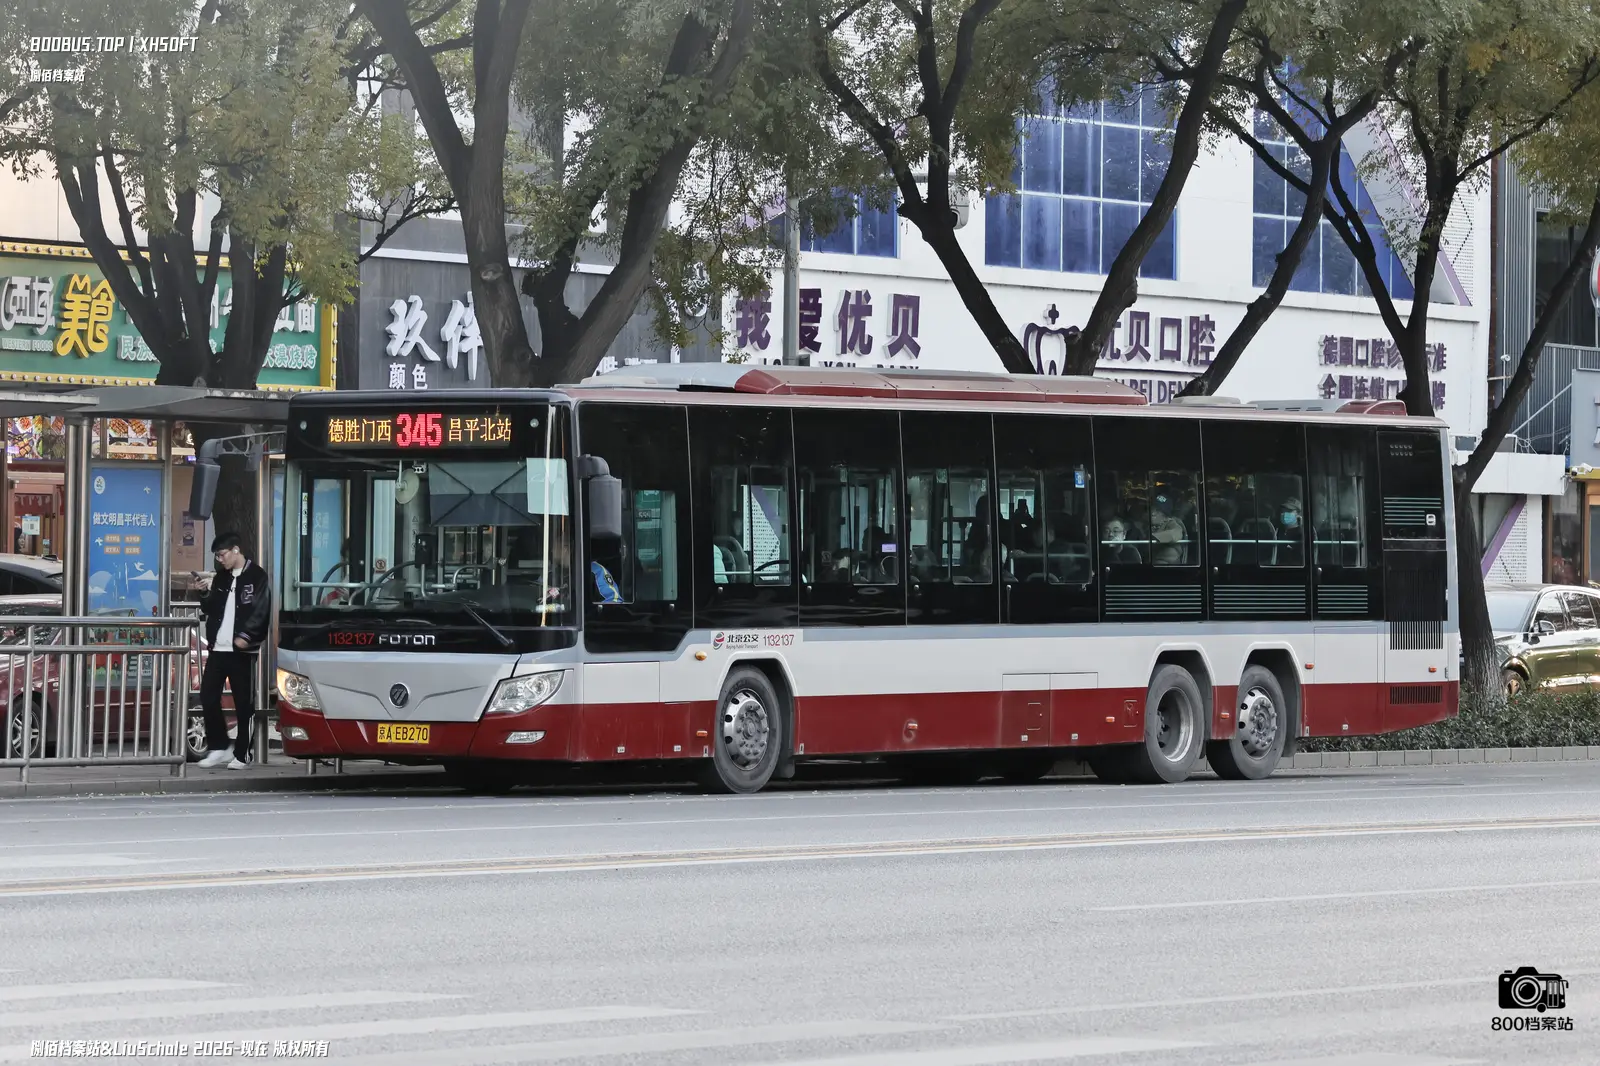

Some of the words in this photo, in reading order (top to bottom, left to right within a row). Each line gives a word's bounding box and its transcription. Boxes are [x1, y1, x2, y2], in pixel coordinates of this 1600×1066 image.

[32, 339, 54, 352] FOODS
[388, 363, 428, 389] 颜色
[328, 418, 392, 443] 德胜门西
[396, 413, 442, 447] 345
[448, 417, 512, 442] 昌平北站
[92, 511, 156, 527] 做文明昌平代言人
[328, 632, 375, 645] 1132137
[378, 634, 436, 646] FOTON
[727, 634, 759, 643] 北京公交
[763, 634, 795, 646] 1132137
